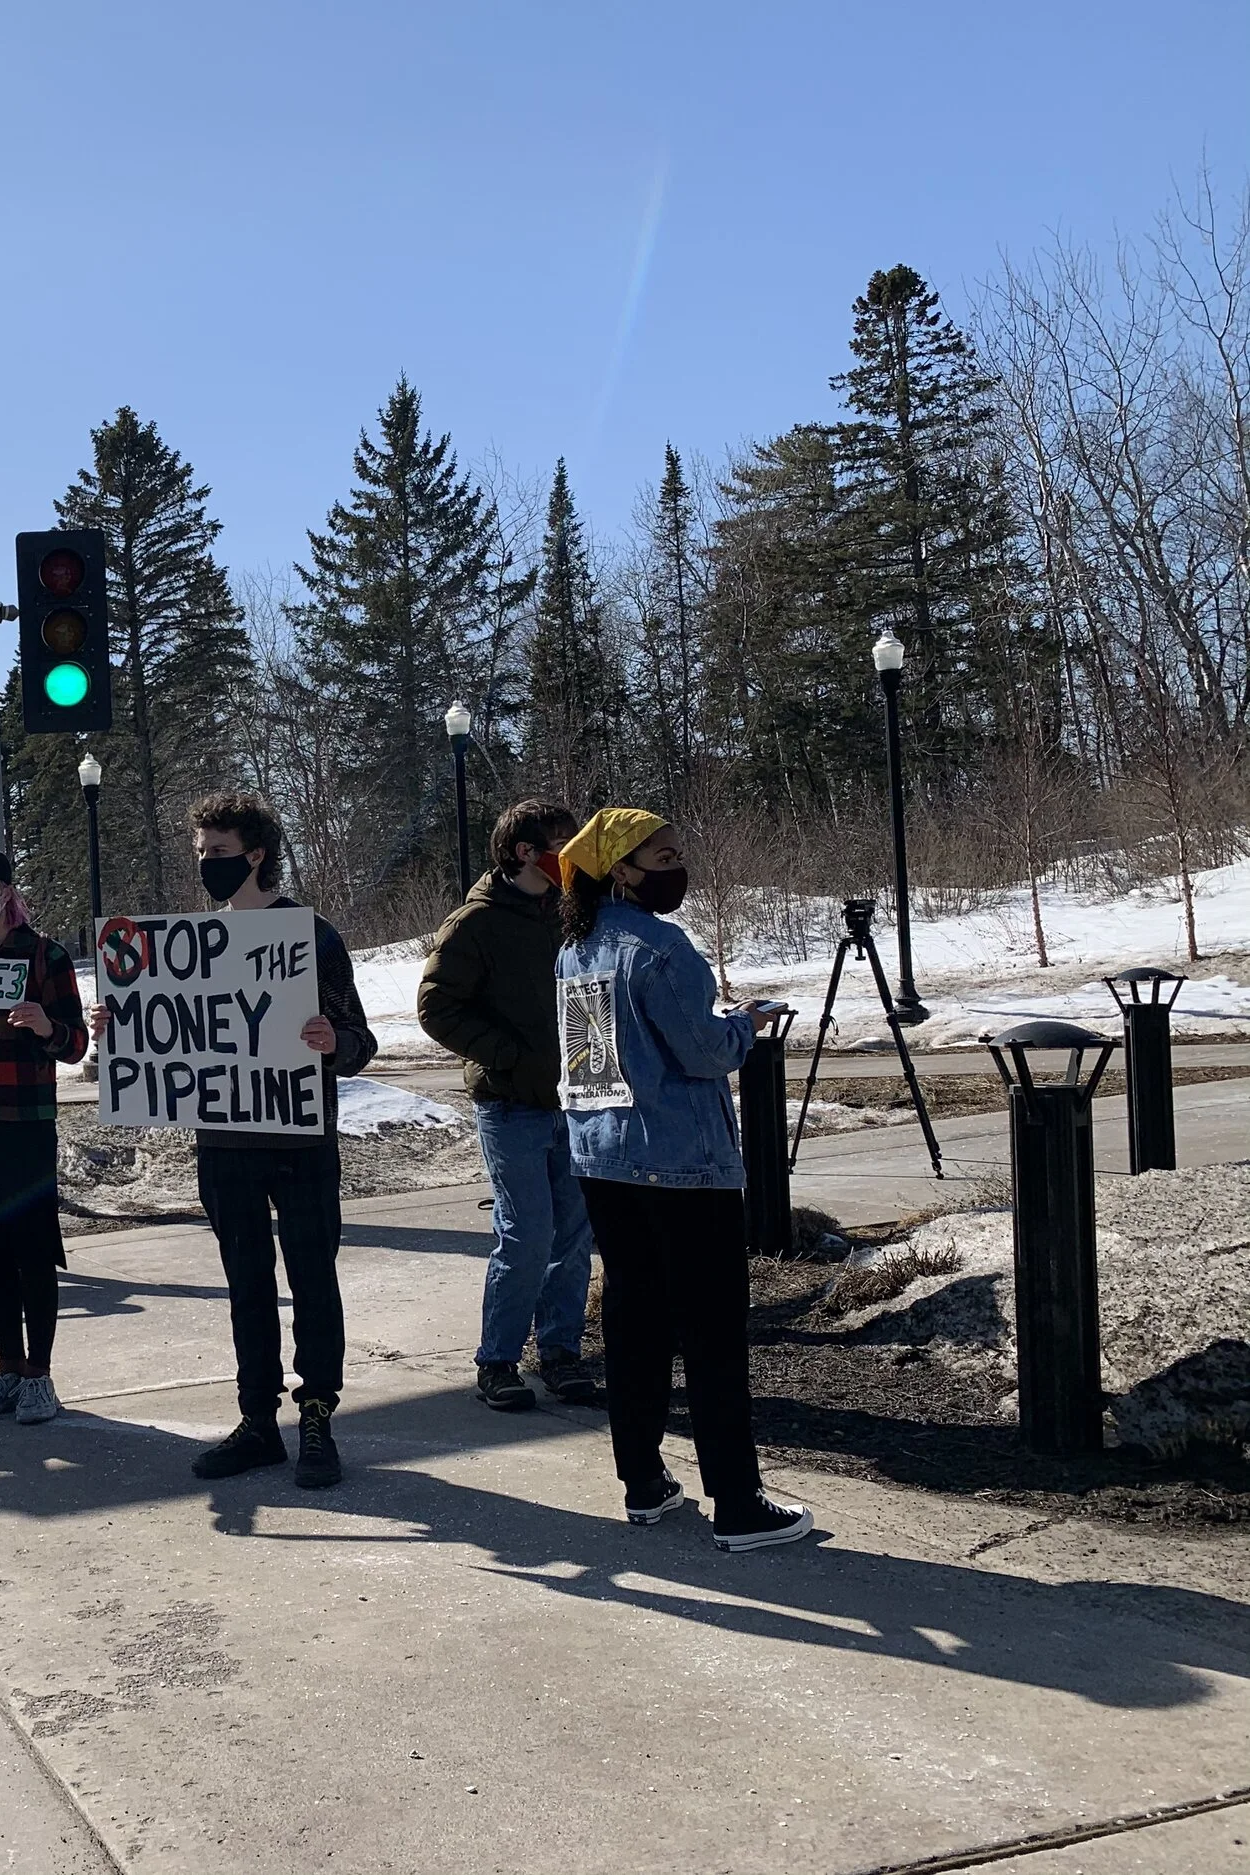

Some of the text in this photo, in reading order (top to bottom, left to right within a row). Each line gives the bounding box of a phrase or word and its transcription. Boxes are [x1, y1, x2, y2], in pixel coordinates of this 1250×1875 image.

[97, 916, 310, 987] STOP THE
[105, 988, 272, 1058] MONEY
[566, 980, 610, 998] PRTECT
[108, 1057, 319, 1128] PIPELINE
[583, 1081, 612, 1092] FUTURE
